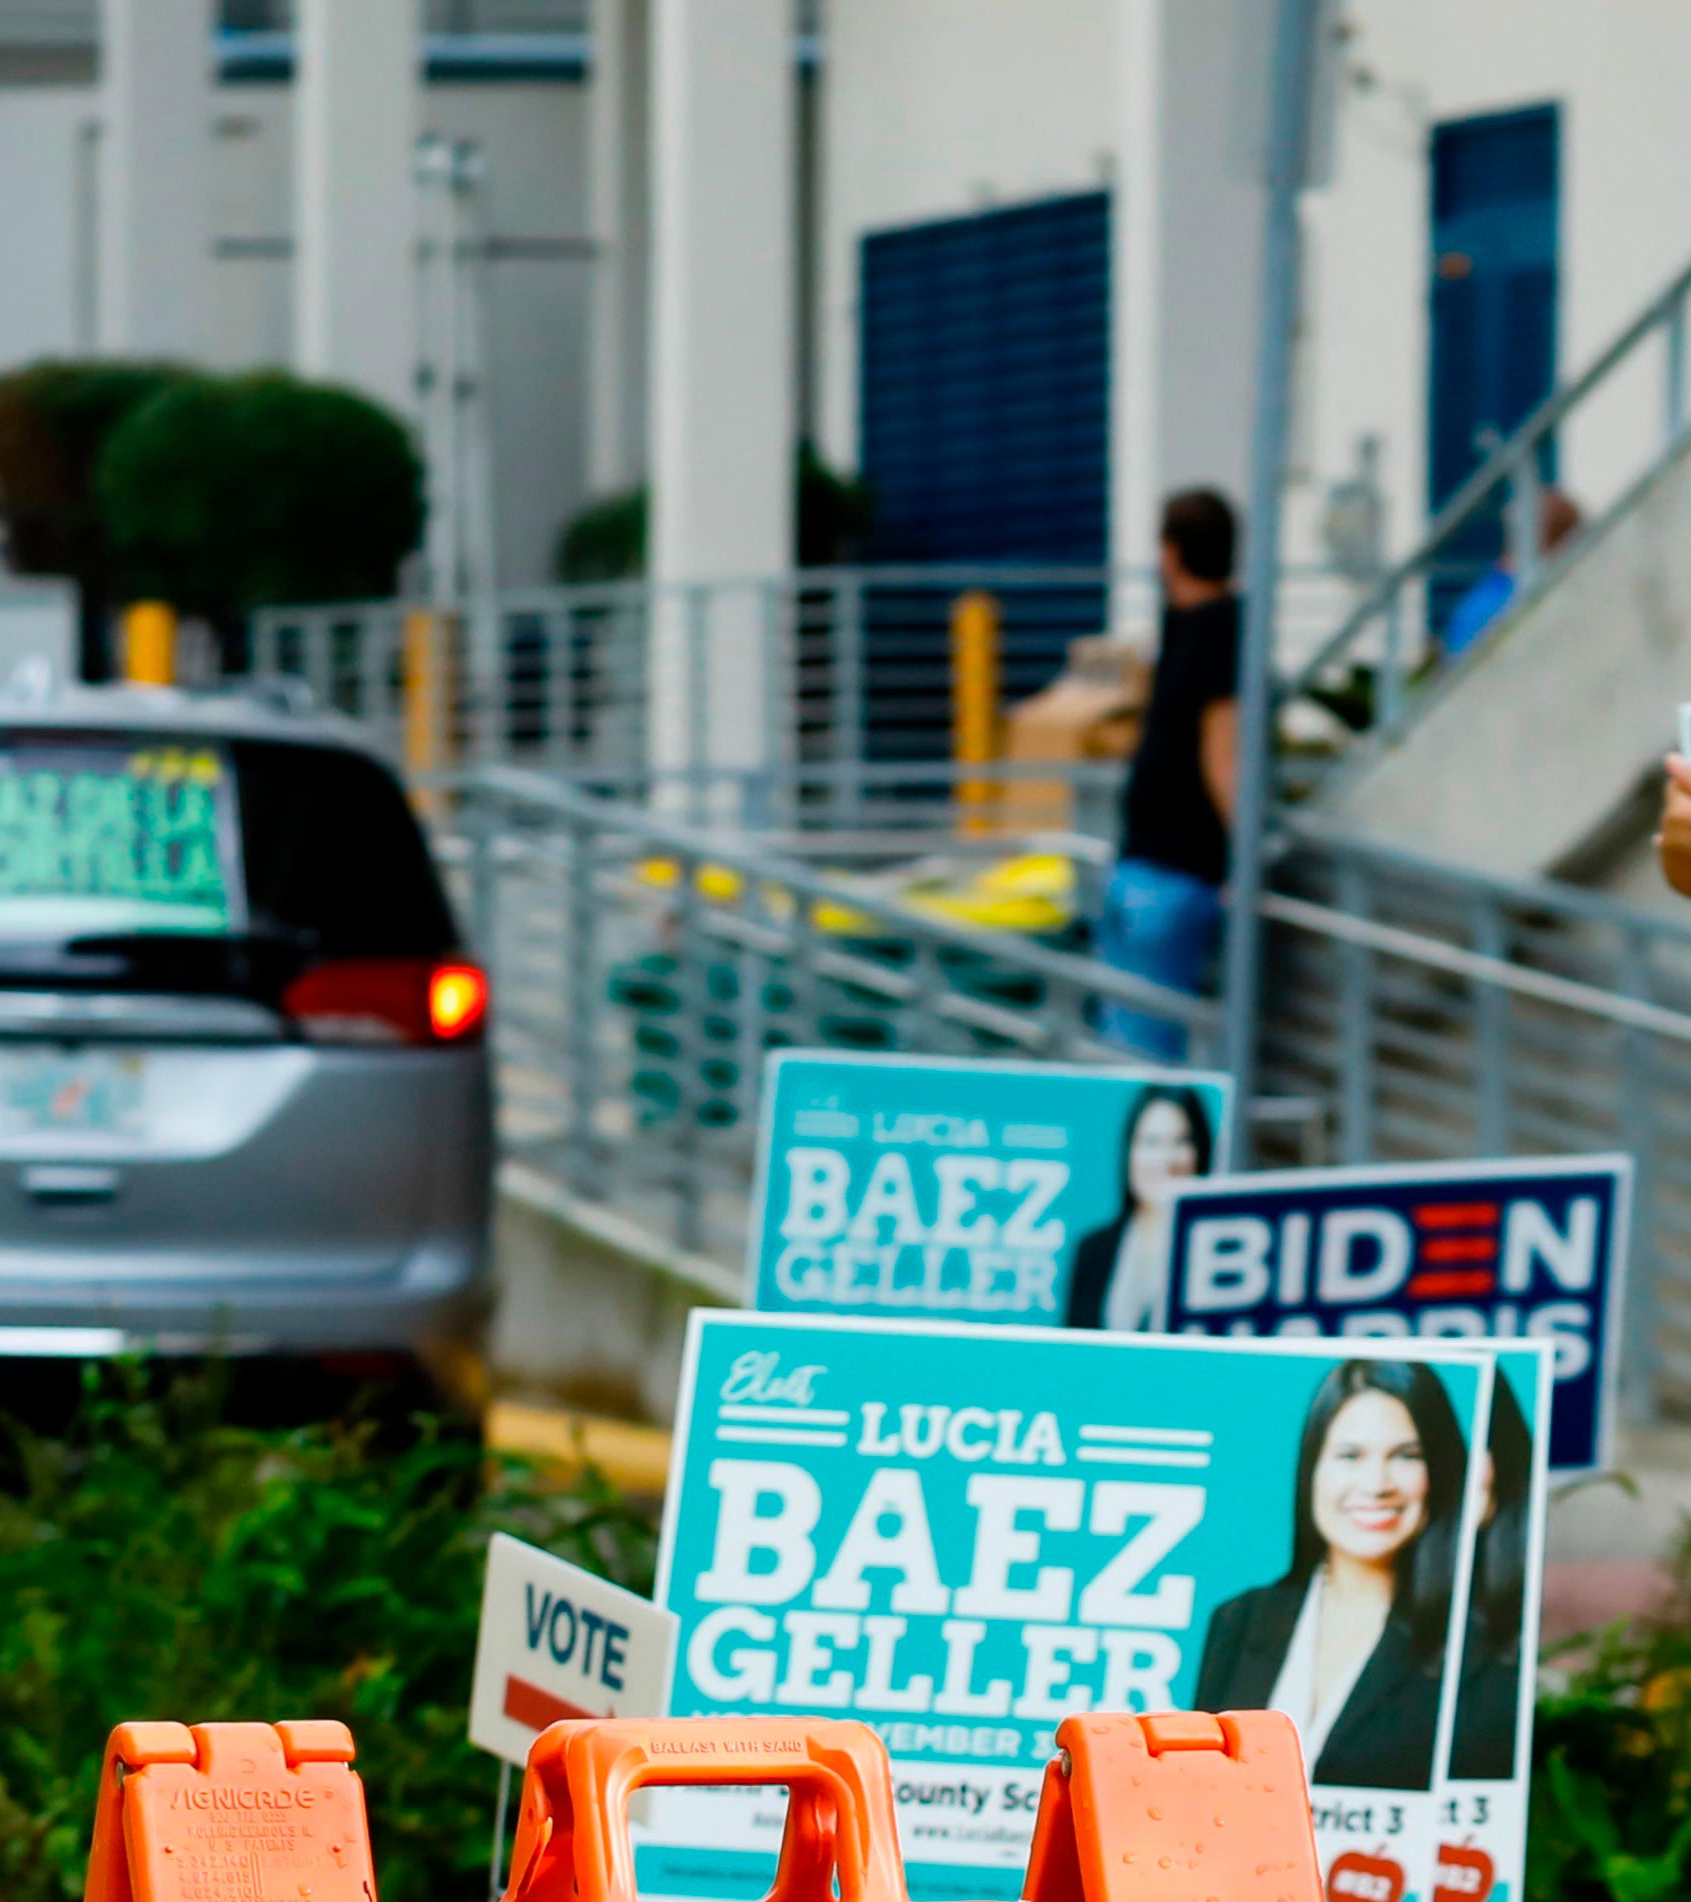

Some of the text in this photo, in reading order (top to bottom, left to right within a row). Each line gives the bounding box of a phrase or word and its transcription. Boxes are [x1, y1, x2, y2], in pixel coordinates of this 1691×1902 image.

[779, 1147, 1070, 1250] BAEZ
[775, 1246, 1057, 1312] GELLER
[1183, 1198, 1600, 1313] BIDEN
[856, 1402, 1066, 1467] LUCIA
[695, 1458, 1206, 1630] BAEZ
[525, 1583, 631, 1692] VOTE
[687, 1607, 1182, 1721] GELLER
[650, 1740, 802, 1754] BALLAST WITH SAND
[892, 1776, 990, 1815] ounty
[1386, 1807, 1404, 1835] 3
